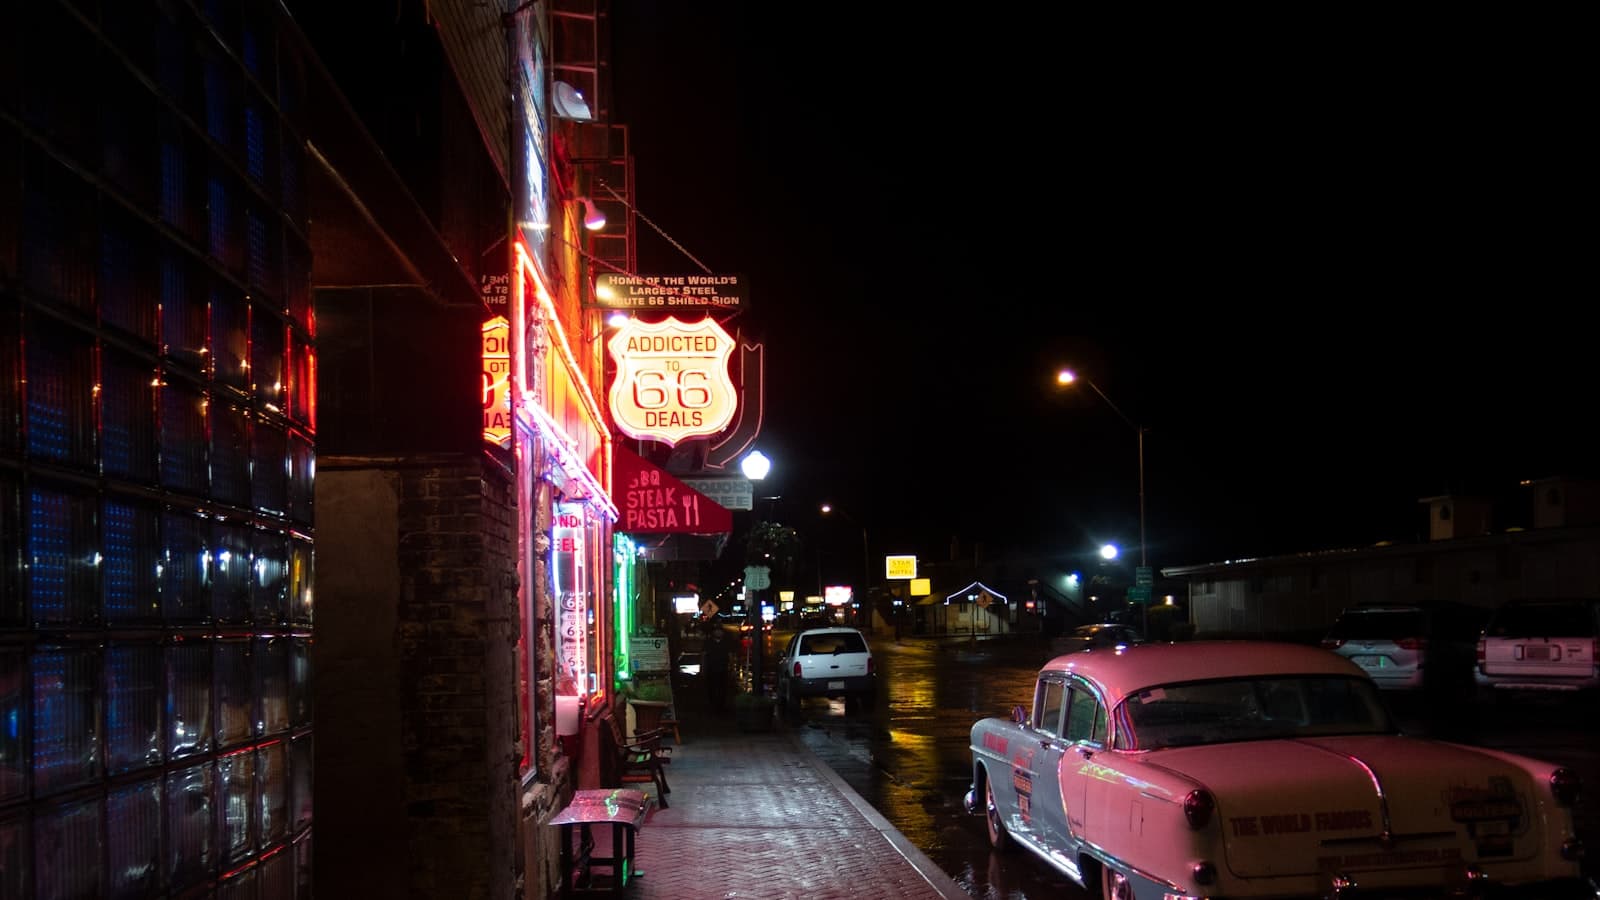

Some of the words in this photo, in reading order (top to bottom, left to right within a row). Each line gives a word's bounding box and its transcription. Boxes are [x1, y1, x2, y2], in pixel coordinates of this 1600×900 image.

[609, 276, 643, 285] HOME
[646, 277, 660, 285] OF
[663, 277, 685, 285] THE
[688, 276, 737, 285] WORLD'S
[630, 286, 680, 295] LARGEST
[683, 286, 718, 295] STEEL
[648, 296, 665, 305] 66
[668, 296, 708, 305] SHIELD
[711, 296, 739, 305] SIGN
[627, 336, 717, 352] ADDICTED
[665, 361, 680, 371] TO
[633, 369, 713, 409] 66
[645, 411, 703, 427] DEALS
[626, 488, 677, 509] STEAK
[626, 508, 678, 529] PASTA
[1229, 816, 1258, 836] THE
